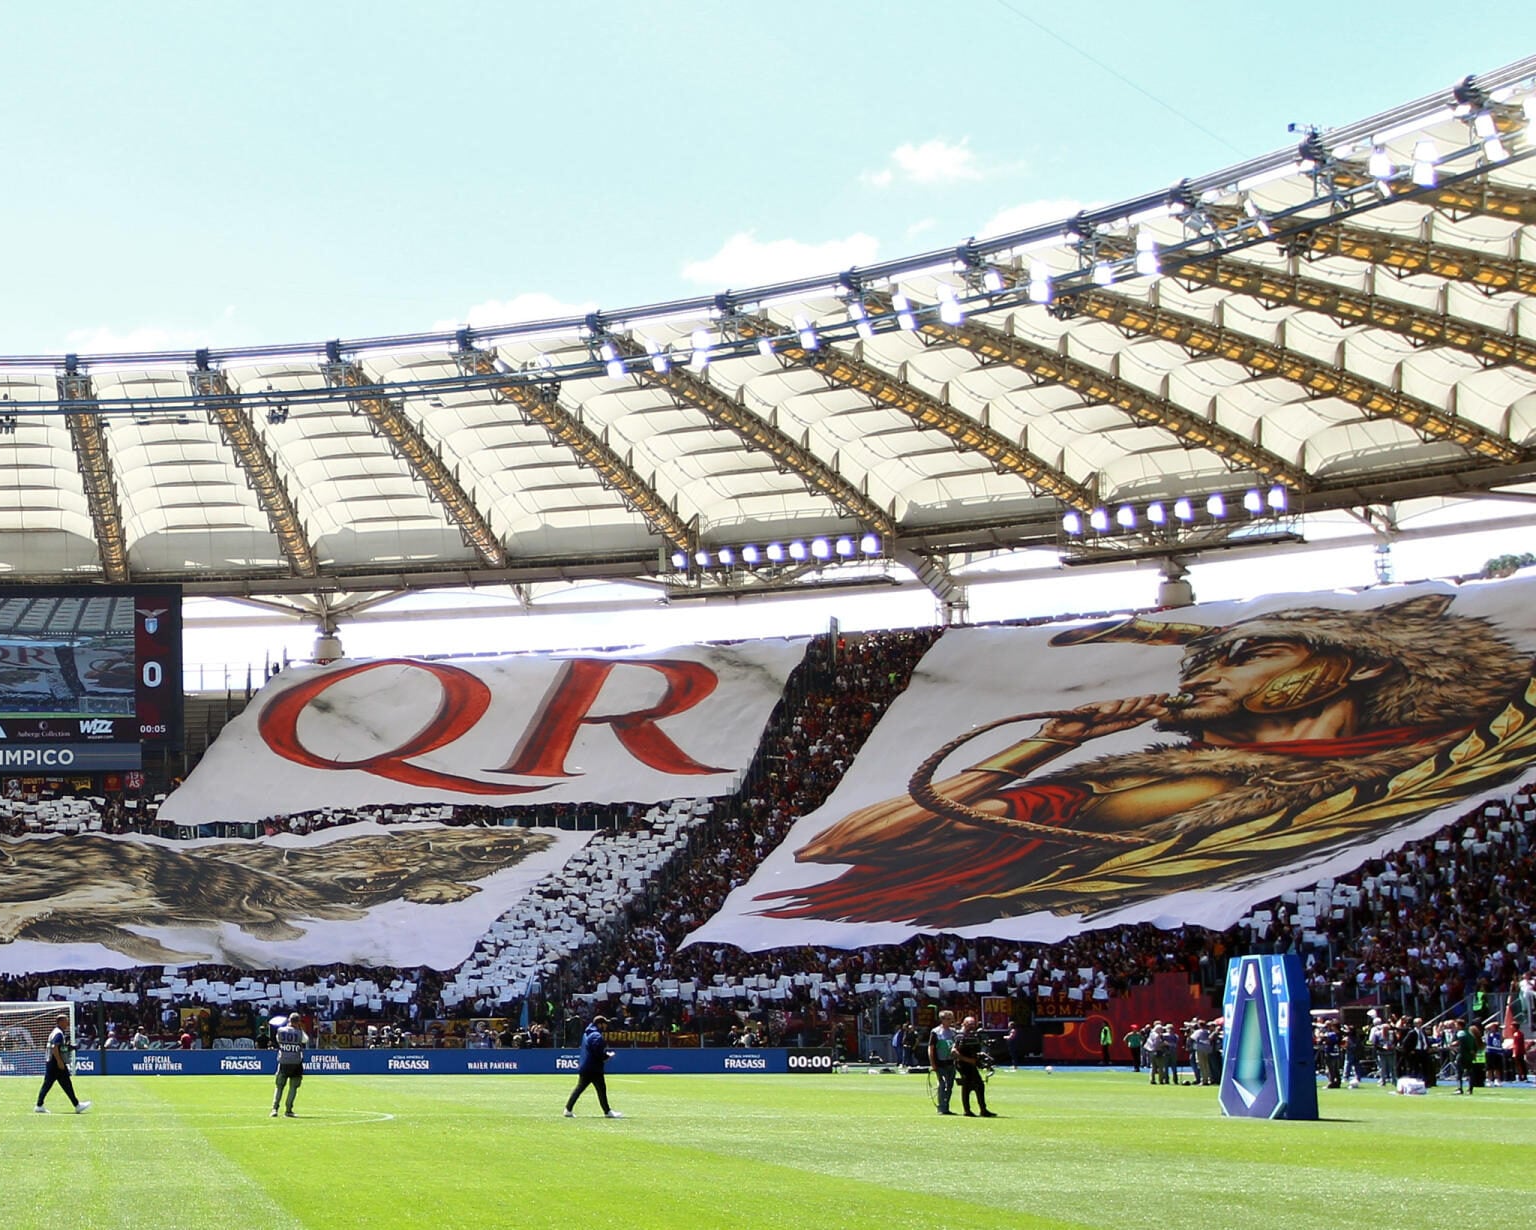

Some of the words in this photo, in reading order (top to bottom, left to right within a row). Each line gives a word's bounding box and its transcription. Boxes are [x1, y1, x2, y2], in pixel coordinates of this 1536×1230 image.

[143, 661, 162, 688] 0
[140, 725, 166, 733] 00:05
[258, 658, 737, 794] QR
[311, 1055, 338, 1063] OFFICIAL
[724, 1058, 766, 1069] FRASASSI
[788, 1056, 831, 1067] 00:00
[132, 1063, 153, 1071] WATER
[154, 1063, 182, 1071] PARTNER
[220, 1060, 261, 1070] FRASASSI
[388, 1060, 429, 1070] FRASASSI
